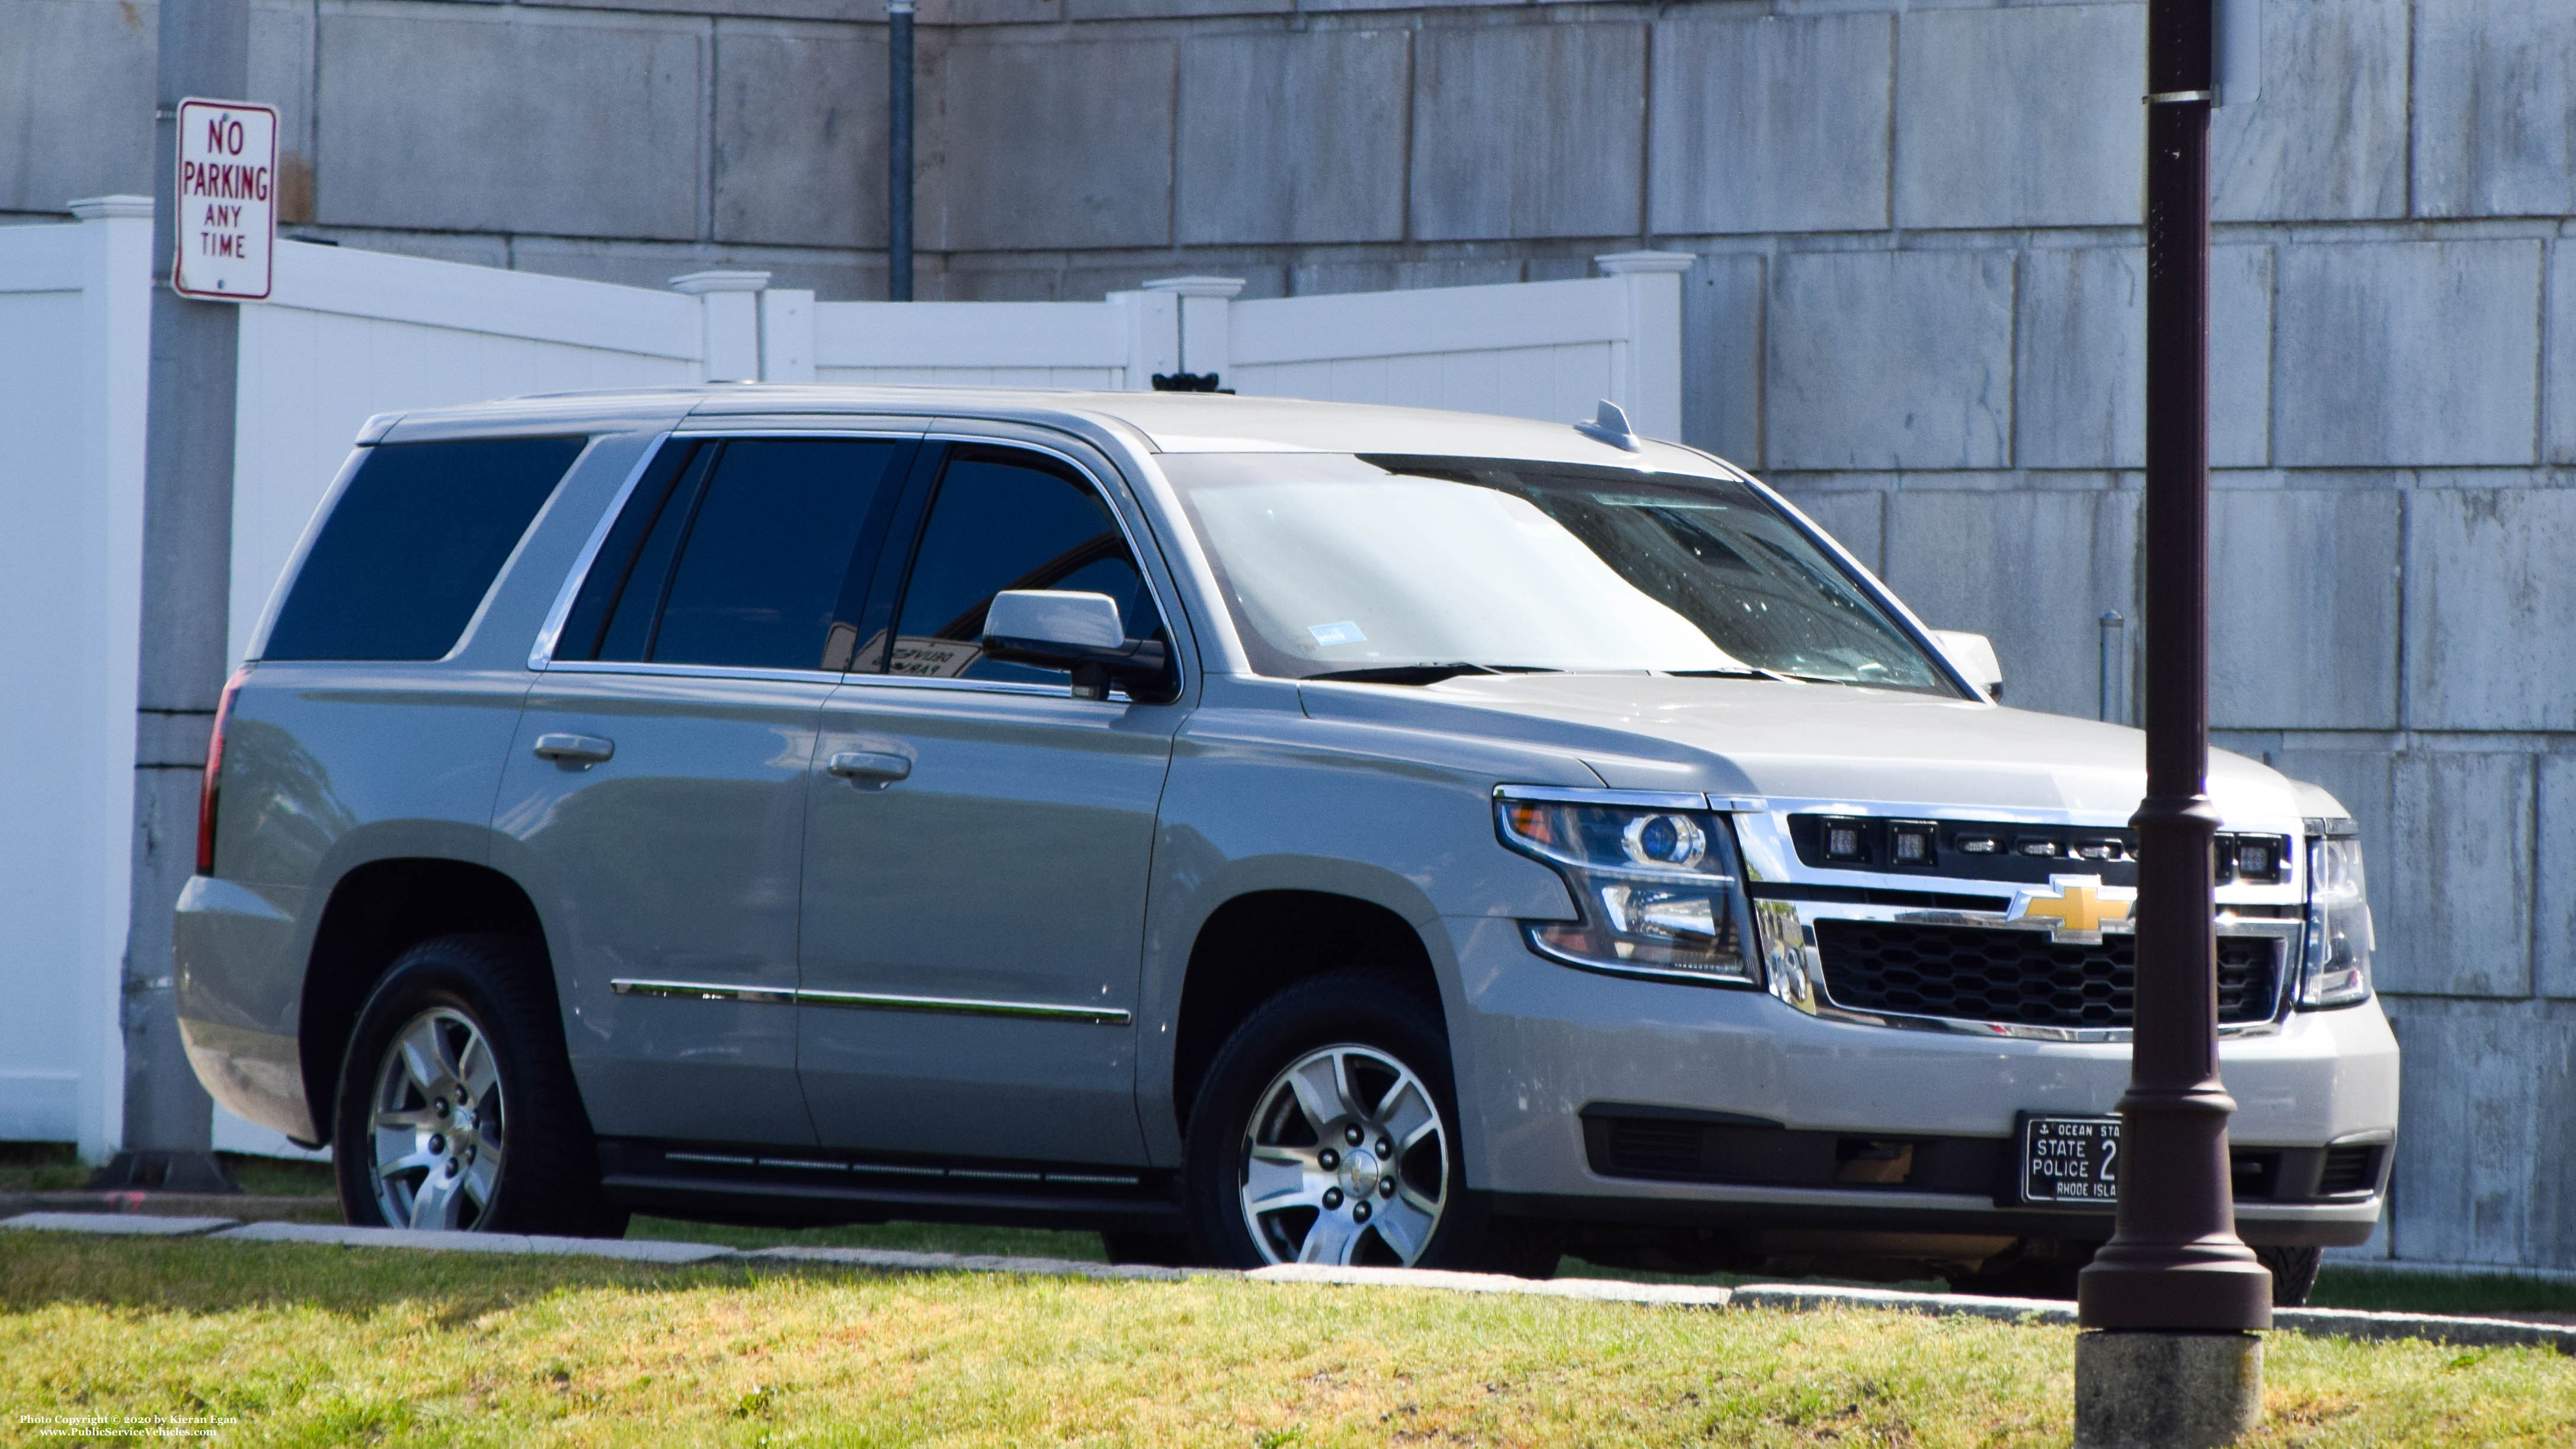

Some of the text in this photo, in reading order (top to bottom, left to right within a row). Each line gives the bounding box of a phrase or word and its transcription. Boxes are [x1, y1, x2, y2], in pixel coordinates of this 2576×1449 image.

[208, 119, 244, 155] NO
[183, 161, 267, 200] PARKING
[204, 204, 241, 228] ANY
[200, 232, 245, 259] TIME
[2058, 1124, 2120, 1138] OCEAN STA
[2037, 1139, 2086, 1157] STATE
[2100, 1139, 2117, 1181] 2
[2033, 1159, 2089, 1178] POLICE
[2057, 1182, 2116, 1197] RHODE ISLA
